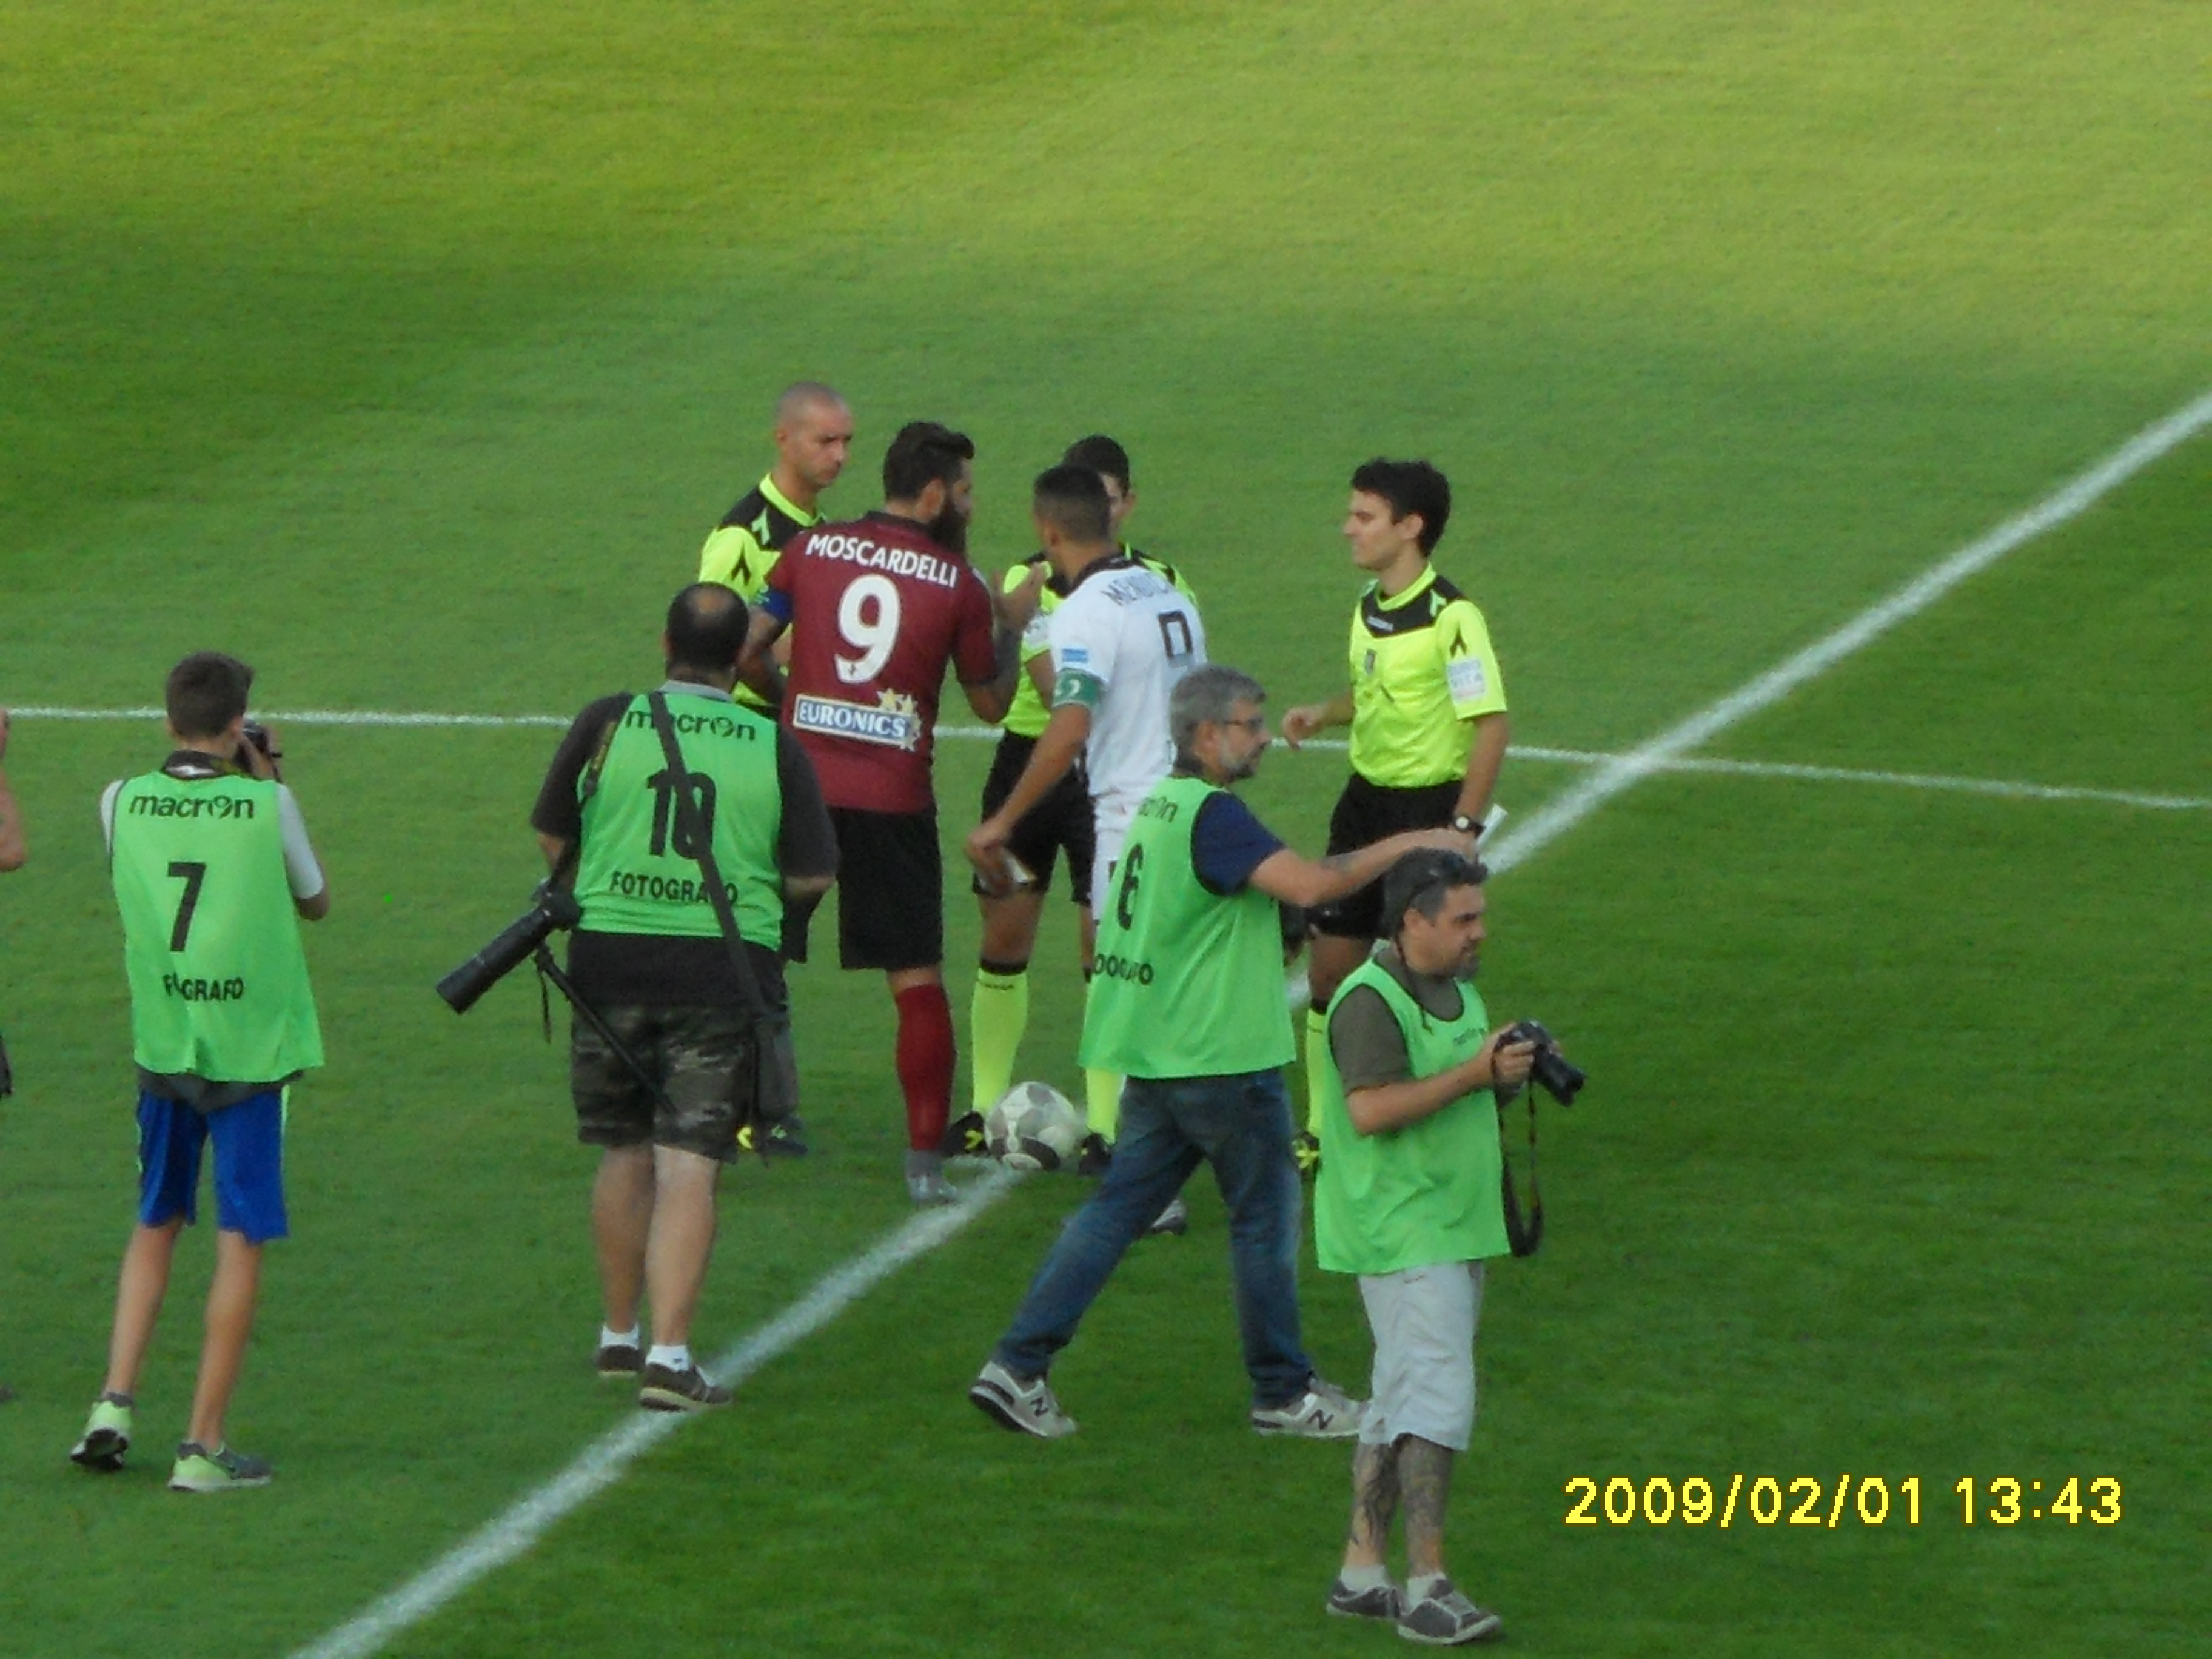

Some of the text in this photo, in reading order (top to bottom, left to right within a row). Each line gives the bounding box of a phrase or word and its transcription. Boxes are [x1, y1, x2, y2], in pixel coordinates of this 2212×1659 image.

[806, 534, 958, 589] MOSCARDELLI
[834, 573, 901, 684] 9
[625, 710, 756, 741] mcron
[799, 701, 906, 738] EURONICS
[129, 794, 255, 819] macron
[167, 861, 207, 952] 7
[609, 871, 738, 906] FOTOGRAO
[1118, 842, 1144, 930] 6
